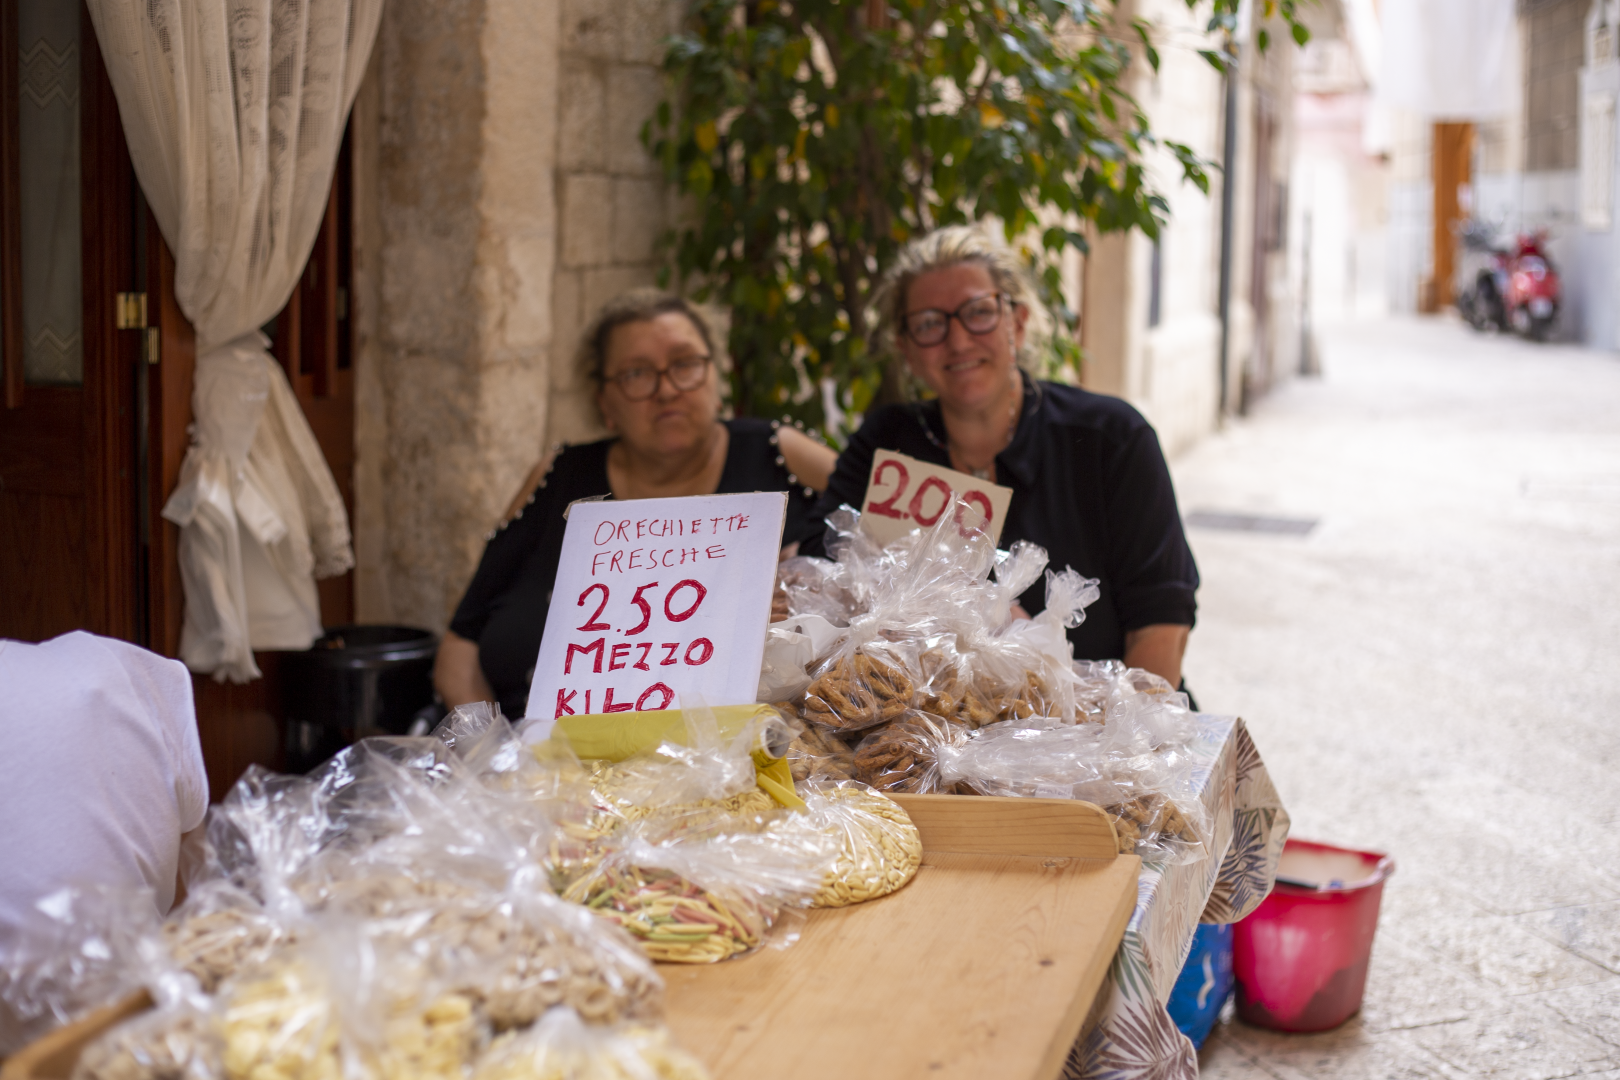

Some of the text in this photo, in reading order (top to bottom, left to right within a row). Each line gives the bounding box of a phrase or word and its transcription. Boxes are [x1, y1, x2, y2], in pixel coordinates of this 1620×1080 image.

[867, 459, 993, 540] 2.00
[594, 513, 750, 546] ORECHIETTE
[591, 544, 727, 576] FRESCHE
[576, 578, 708, 636] 2.50
[563, 637, 715, 675] MEZZO
[554, 681, 676, 720] KILO
